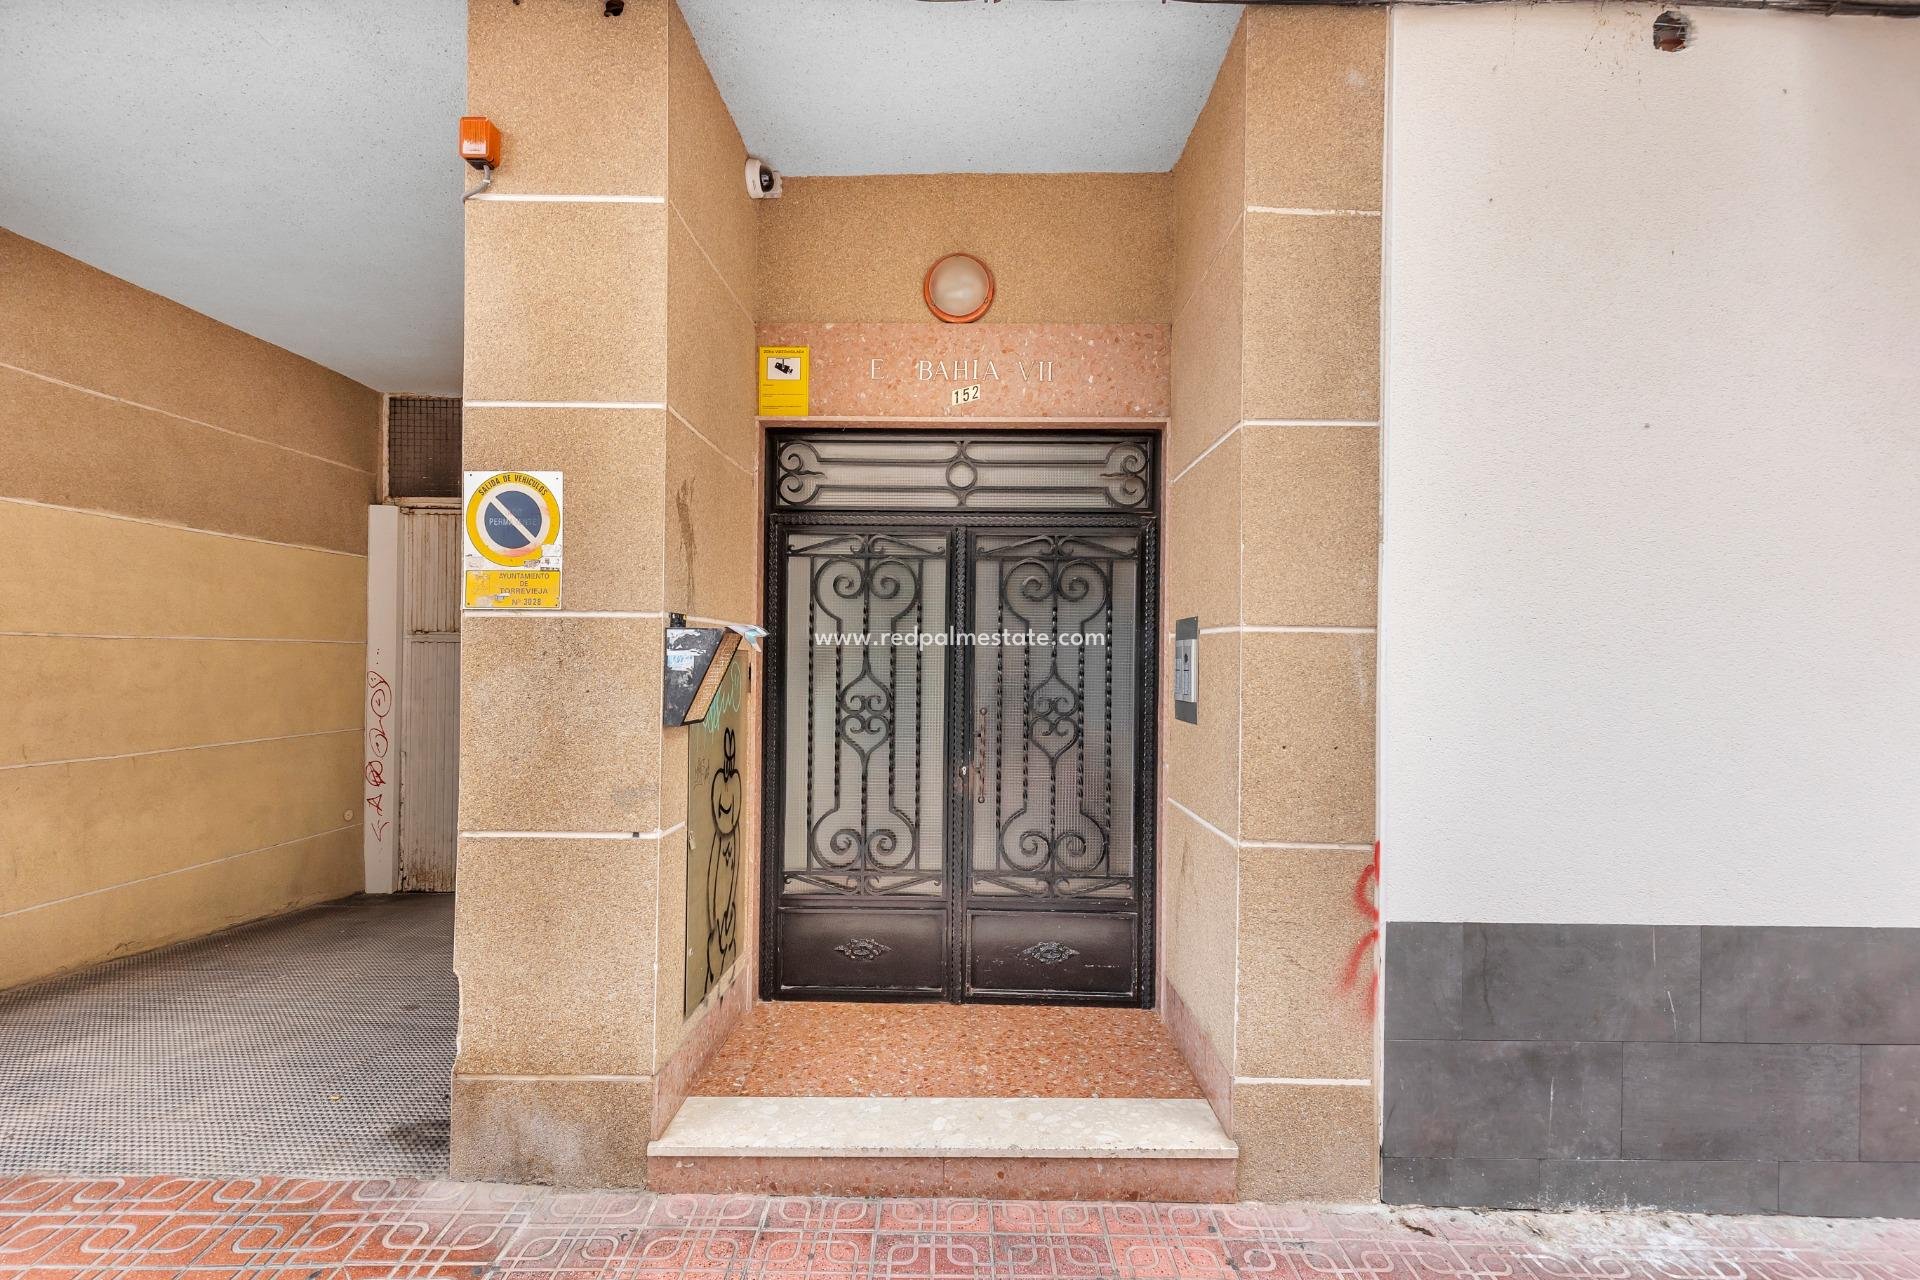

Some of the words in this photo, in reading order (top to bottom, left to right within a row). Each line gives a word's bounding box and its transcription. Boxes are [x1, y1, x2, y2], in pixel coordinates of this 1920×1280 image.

[918, 359, 999, 381] BAHIA
[1018, 361, 1053, 381] VII
[954, 386, 979, 404] 152
[478, 478, 501, 496] SALIDA
[502, 474, 511, 482] DE
[514, 474, 548, 496] VEHICULOS
